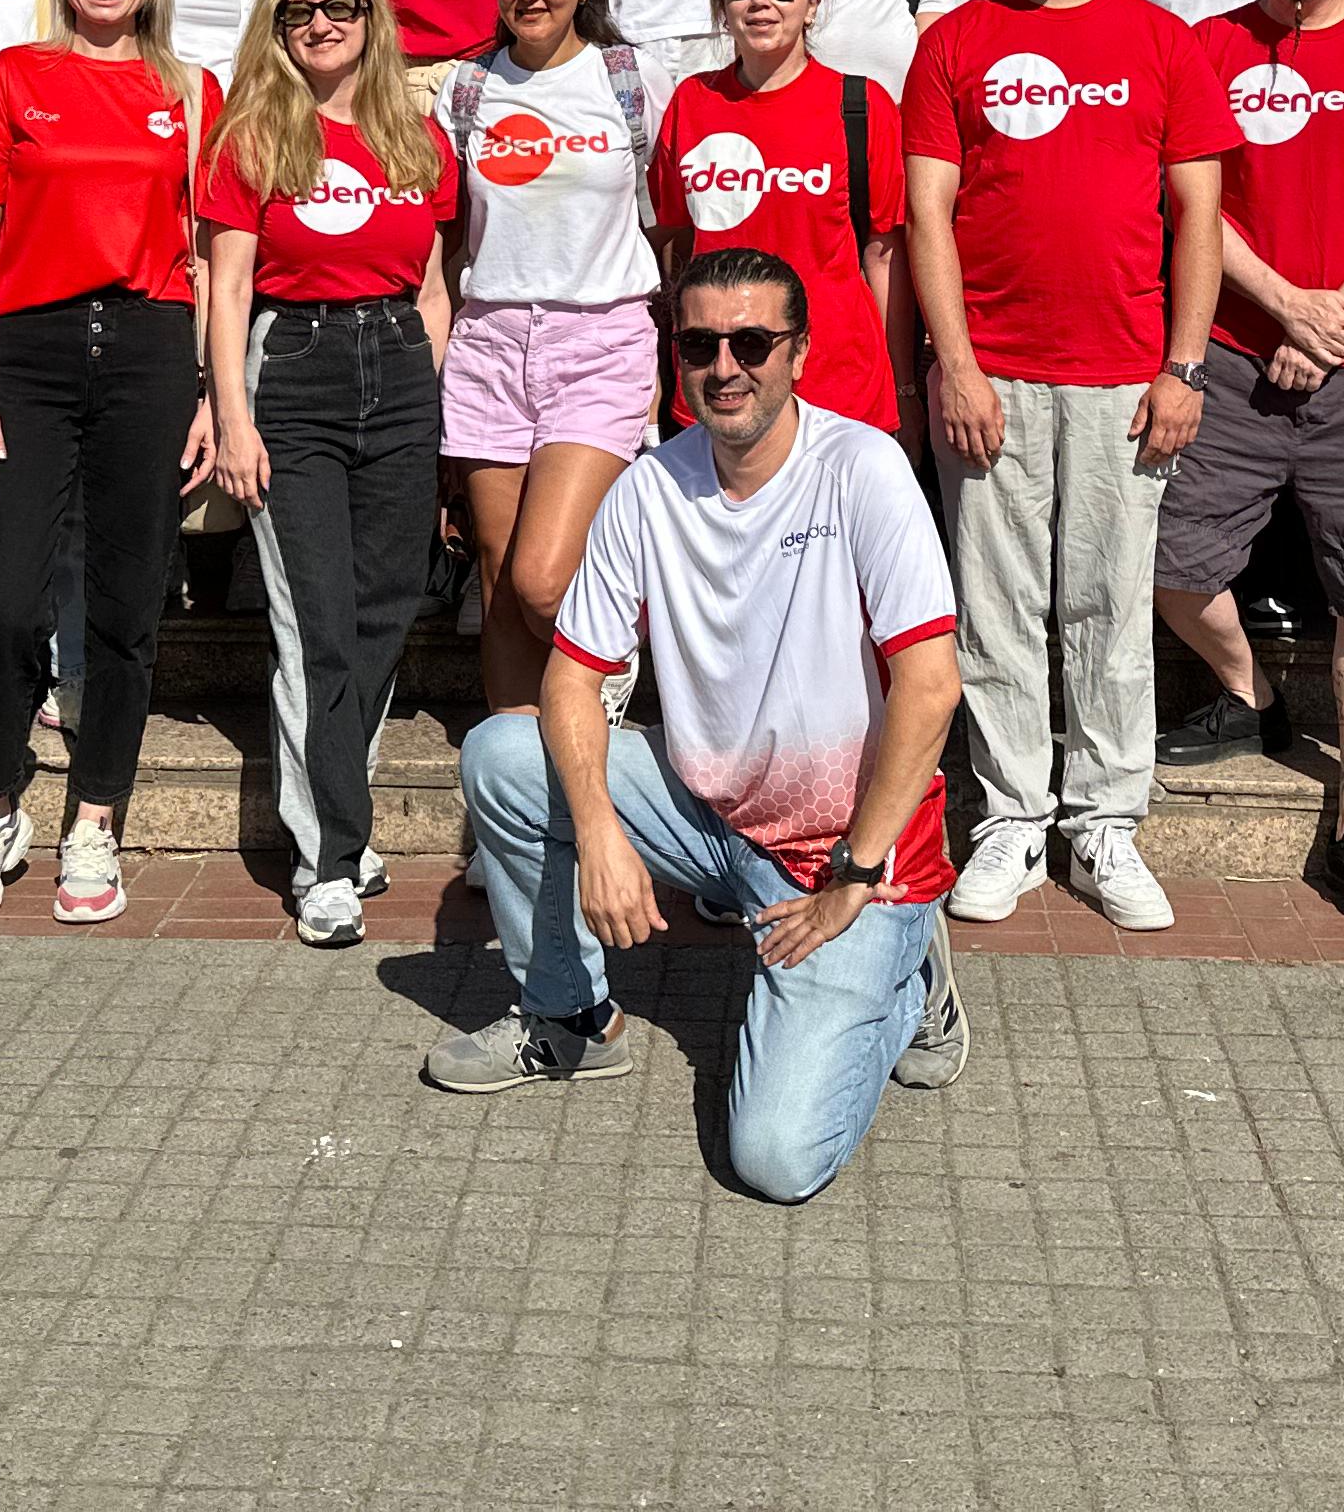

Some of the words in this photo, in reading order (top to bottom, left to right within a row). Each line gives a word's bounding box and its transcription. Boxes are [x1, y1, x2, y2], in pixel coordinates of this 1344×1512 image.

[982, 77, 1131, 109] Edenred
[478, 130, 610, 161] Edenred
[679, 159, 832, 196] Edenred
